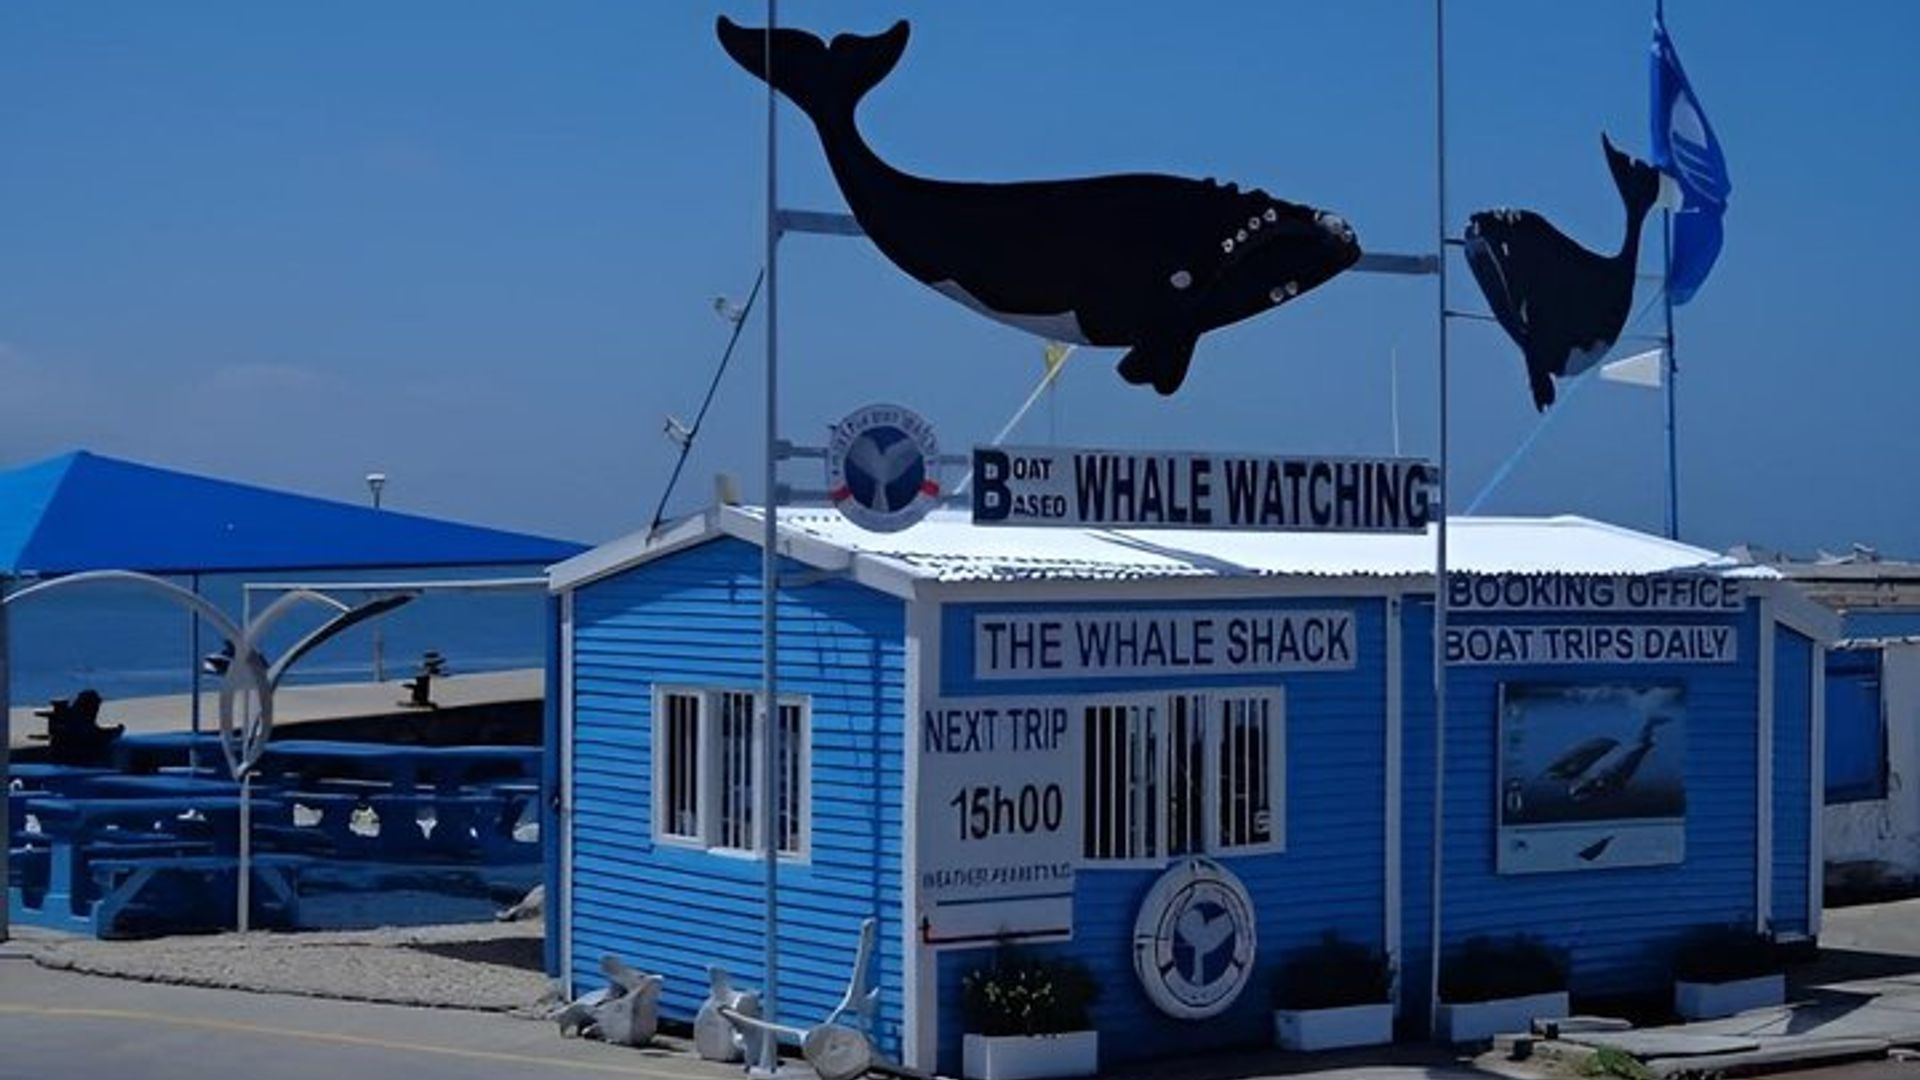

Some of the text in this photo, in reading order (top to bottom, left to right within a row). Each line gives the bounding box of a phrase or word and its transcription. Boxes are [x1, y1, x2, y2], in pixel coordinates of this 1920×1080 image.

[1074, 454, 1429, 528] WHALE WATCHING
[1449, 574, 1740, 608] BOOKING OFFICE
[983, 617, 1350, 670] THE WHALE SHACK
[1445, 627, 1729, 661] BOAT TRIPS DAILY
[925, 706, 1068, 753] NEXT TRIP
[949, 783, 1063, 841] 15h00
